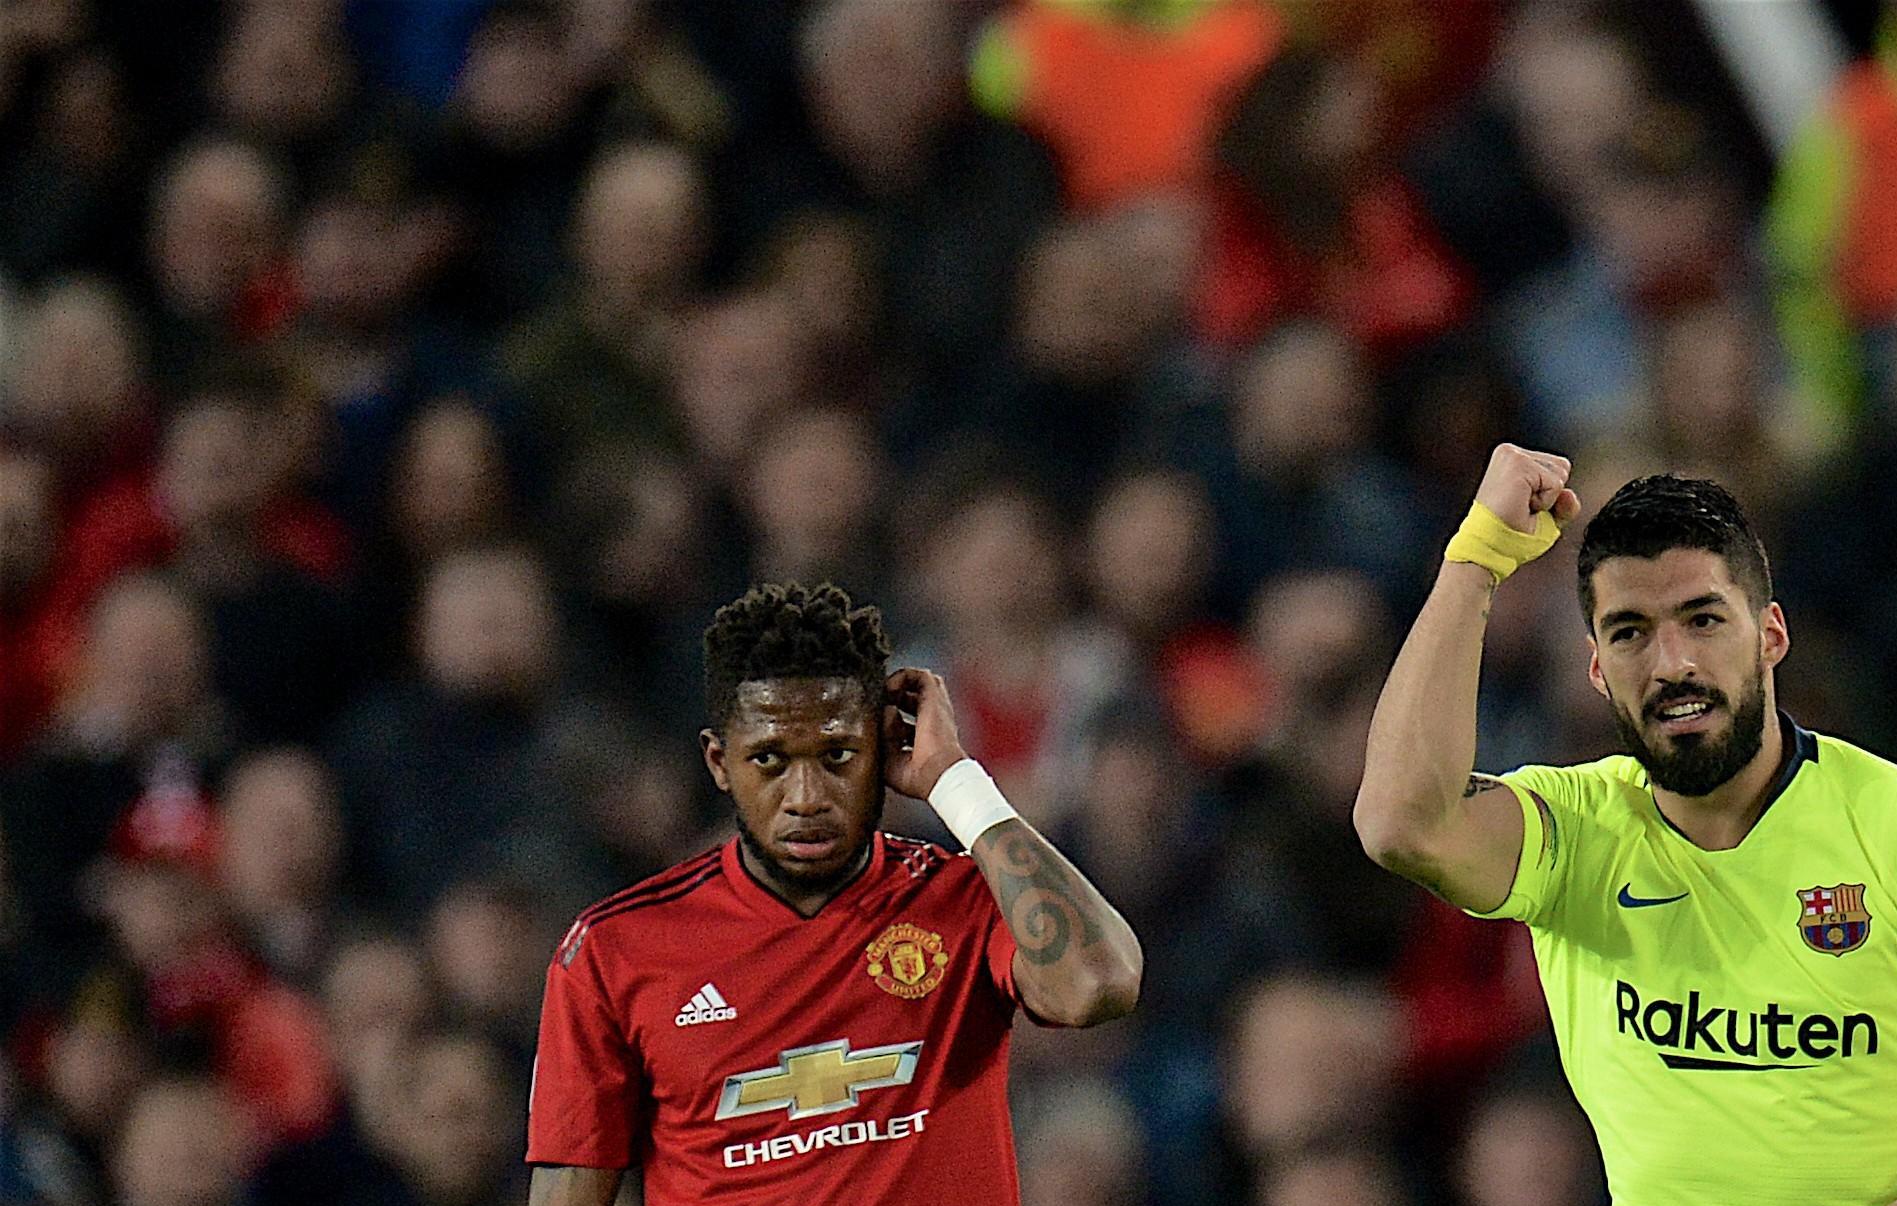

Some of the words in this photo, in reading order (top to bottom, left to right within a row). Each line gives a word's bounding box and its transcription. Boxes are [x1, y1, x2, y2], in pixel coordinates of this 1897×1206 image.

[674, 1007, 738, 1027] adidas
[1616, 979, 1878, 1061] Rakuten
[723, 1109, 929, 1168] CHEVROLET
